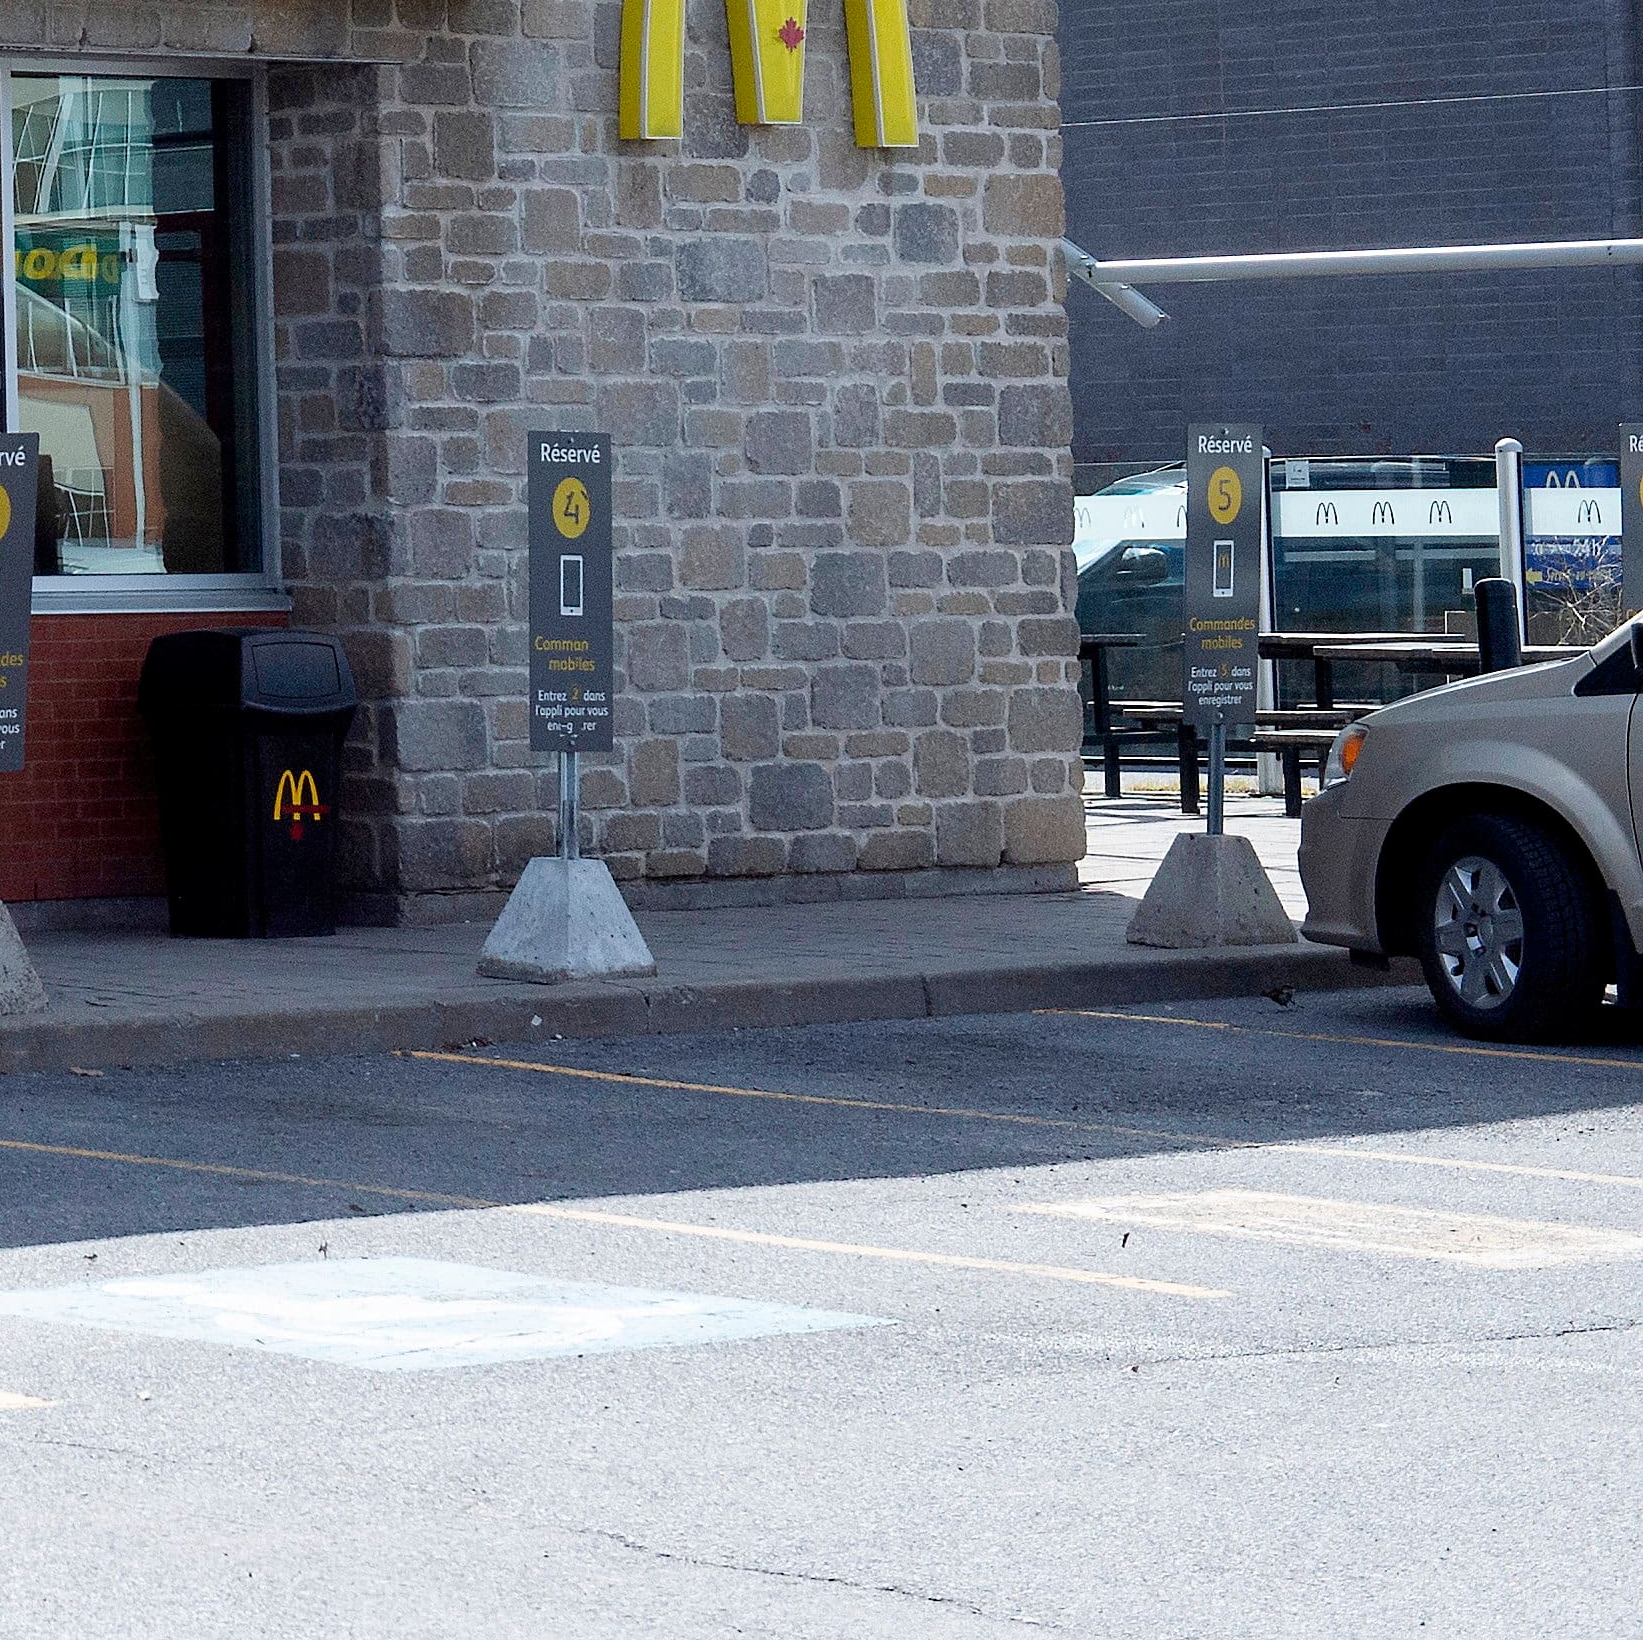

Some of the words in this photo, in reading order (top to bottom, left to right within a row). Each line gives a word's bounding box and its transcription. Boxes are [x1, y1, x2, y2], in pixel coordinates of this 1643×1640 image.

[1198, 435, 1253, 453] Réservé
[539, 443, 601, 463] Réservé
[1218, 479, 1232, 511] 5
[563, 491, 580, 525] 4
[1189, 617, 1256, 632] Commandes
[535, 635, 589, 651] Comman
[1201, 635, 1244, 649] mobiles
[1190, 667, 1218, 678] Entrez
[1231, 666, 1252, 677] dans
[1188, 680, 1213, 694] l'appli
[1214, 682, 1233, 693] pour
[1234, 681, 1254, 691] vous
[538, 689, 568, 702] Entrez
[583, 689, 606, 702] dans
[1198, 694, 1243, 708] enregistrer
[535, 704, 563, 718] l'appli
[564, 706, 586, 718] pour
[586, 706, 609, 717] vous
